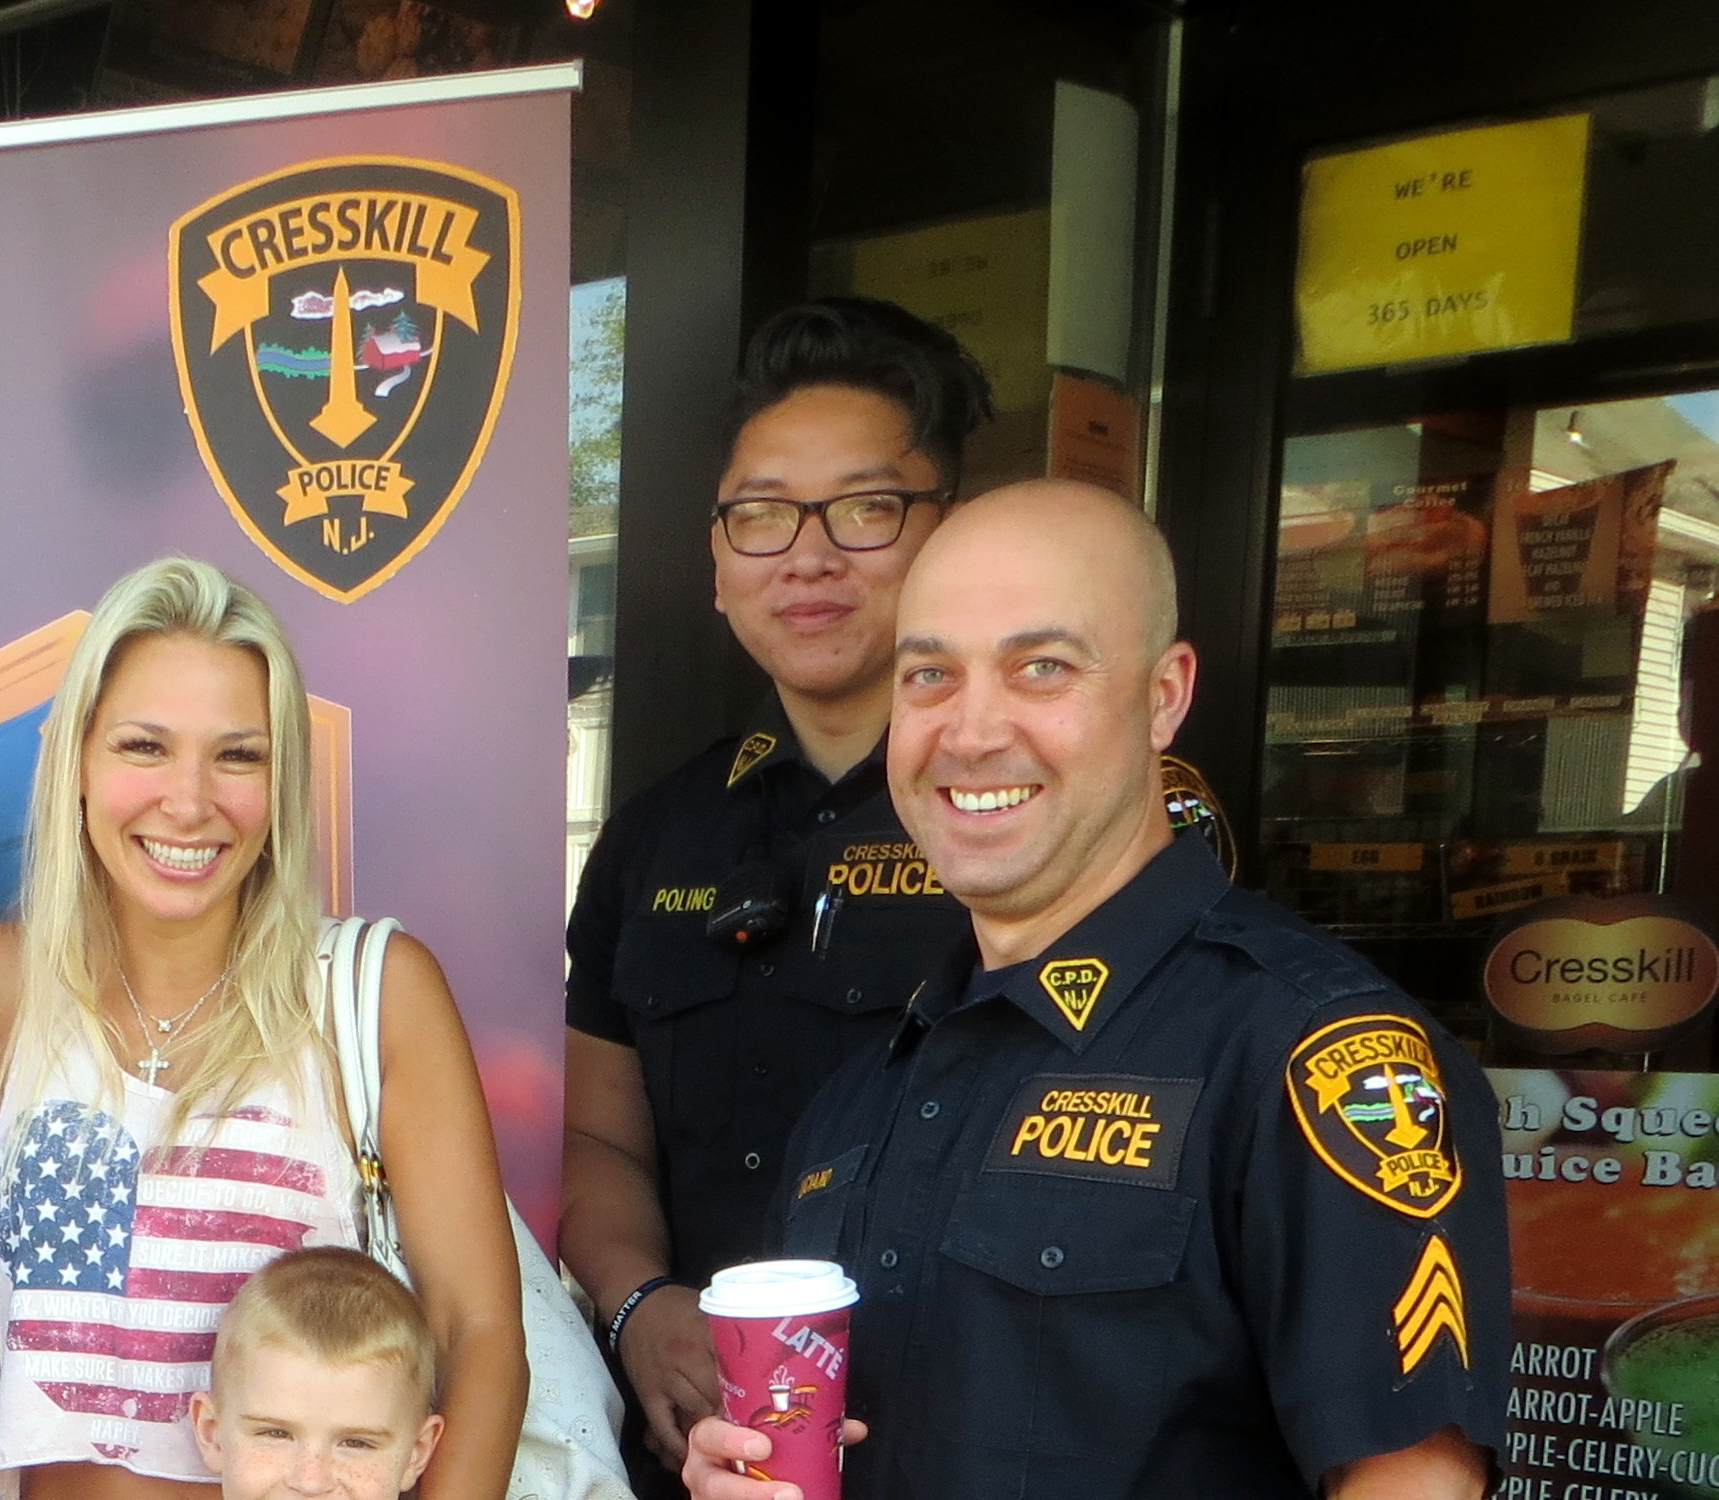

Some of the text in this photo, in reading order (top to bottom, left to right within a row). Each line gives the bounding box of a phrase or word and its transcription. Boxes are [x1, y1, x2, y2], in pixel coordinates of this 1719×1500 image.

[1394, 169, 1474, 201] WE'RE
[220, 198, 457, 280] CRESSKILL
[1395, 233, 1458, 261] OPEN
[1366, 291, 1489, 326] 365 DAYS
[298, 463, 391, 497] POLICE
[322, 516, 374, 555] N.J.
[843, 843, 926, 861] CRESSKI
[828, 861, 944, 895] POLICE
[652, 887, 717, 912] POLING
[1050, 969, 1097, 987] C.P.D.
[1510, 948, 1695, 985] Cresskill
[1552, 992, 1599, 1003] BAGEL
[1314, 1034, 1432, 1079] CRESSKILL
[1041, 1090, 1153, 1119] CRESSKILL
[1562, 1096, 1719, 1142] Sque
[1011, 1115, 1161, 1168] POLICE
[1386, 1155, 1442, 1176] POLICE
[144, 1180, 208, 1204] DECIDE
[215, 1183, 235, 1206] TO
[138, 1242, 186, 1266] SURE
[190, 1244, 206, 1267] IT
[44, 1296, 126, 1322] WHATEVER
[130, 1303, 159, 1325] YOU
[612, 1291, 642, 1332] MATTER
[24, 1355, 70, 1378] MAKE
[75, 1358, 115, 1382] SURE
[133, 1365, 185, 1387] MAKES
